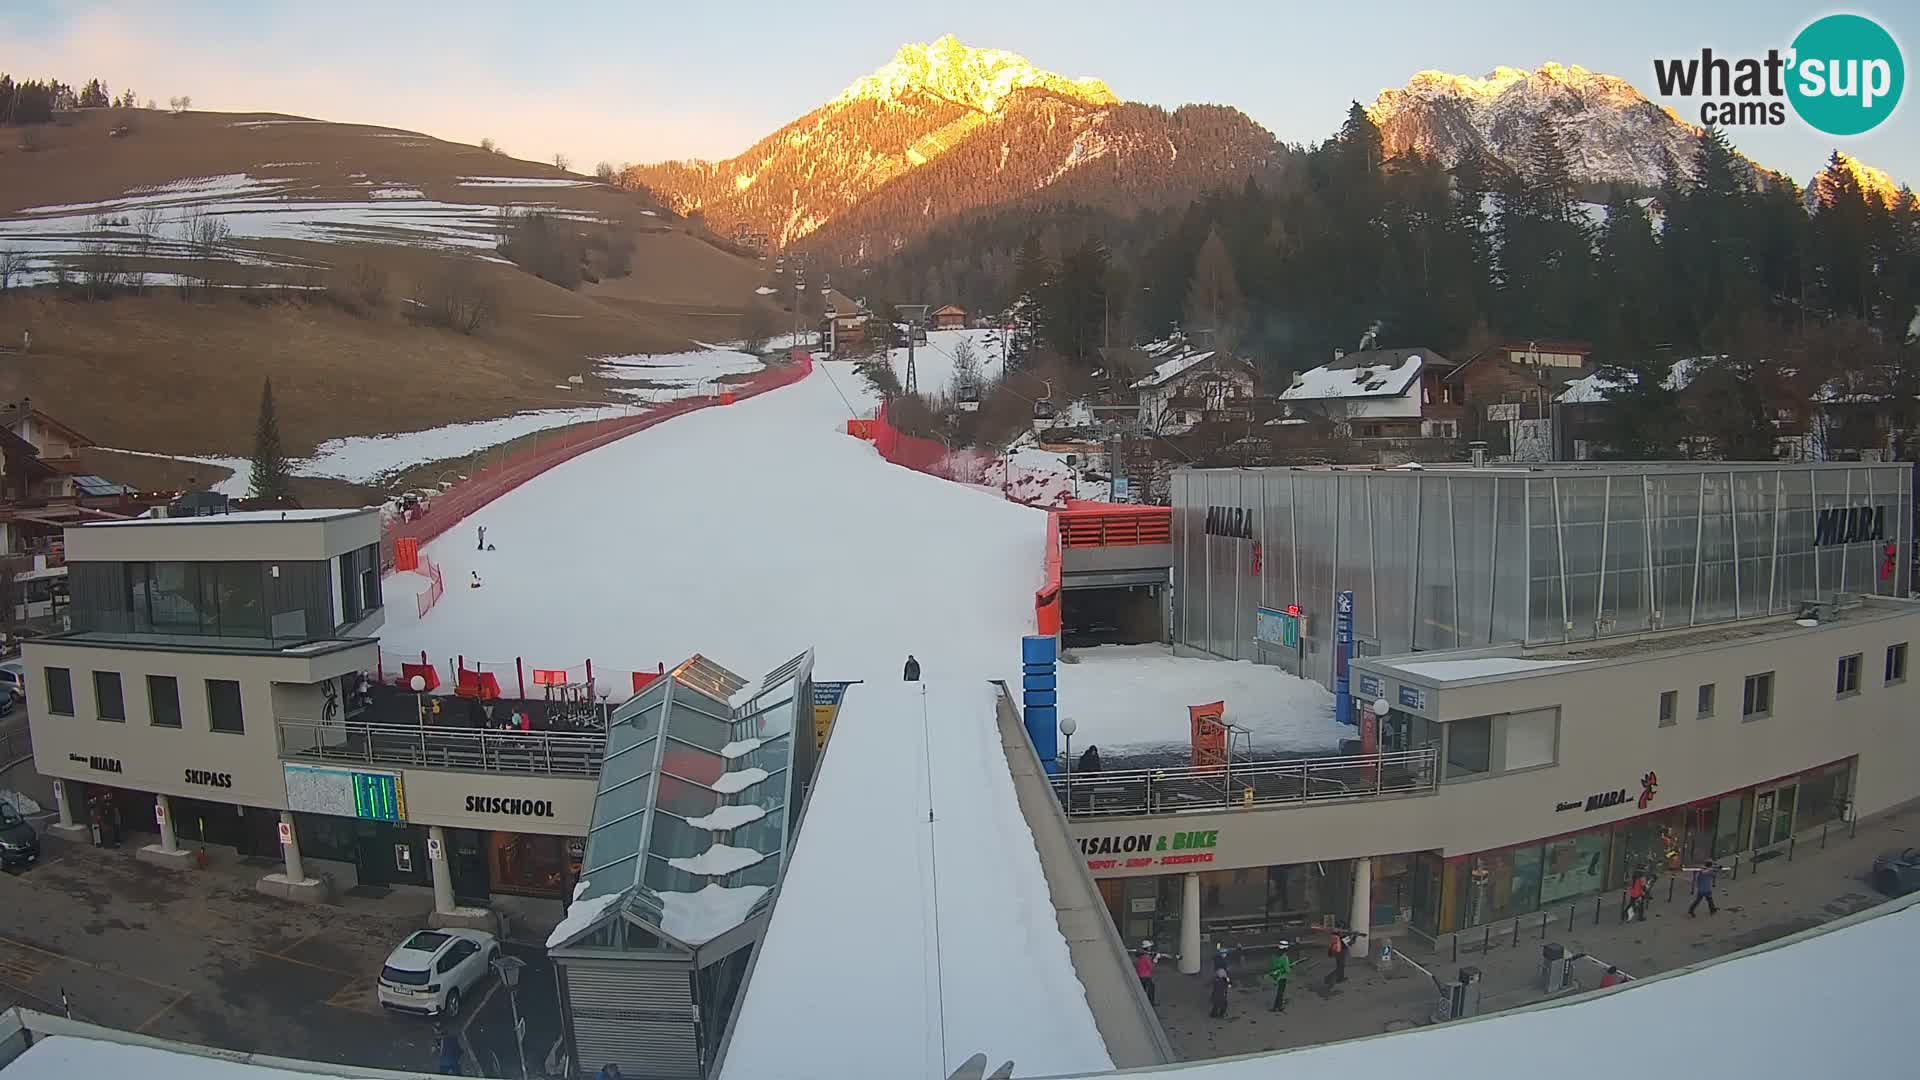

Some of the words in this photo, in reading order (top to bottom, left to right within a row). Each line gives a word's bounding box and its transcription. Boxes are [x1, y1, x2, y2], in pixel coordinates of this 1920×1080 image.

[1205, 505, 1253, 540] MIARA
[1813, 505, 1884, 547] MIARA
[90, 756, 122, 774] MIARA
[184, 769, 232, 788] SKIPASS
[465, 795, 554, 818] SKISCHOOL
[1584, 789, 1625, 812] MIARA
[1075, 835, 1152, 855] ISALON
[1156, 836, 1168, 851] &
[1172, 830, 1218, 850] BIKE
